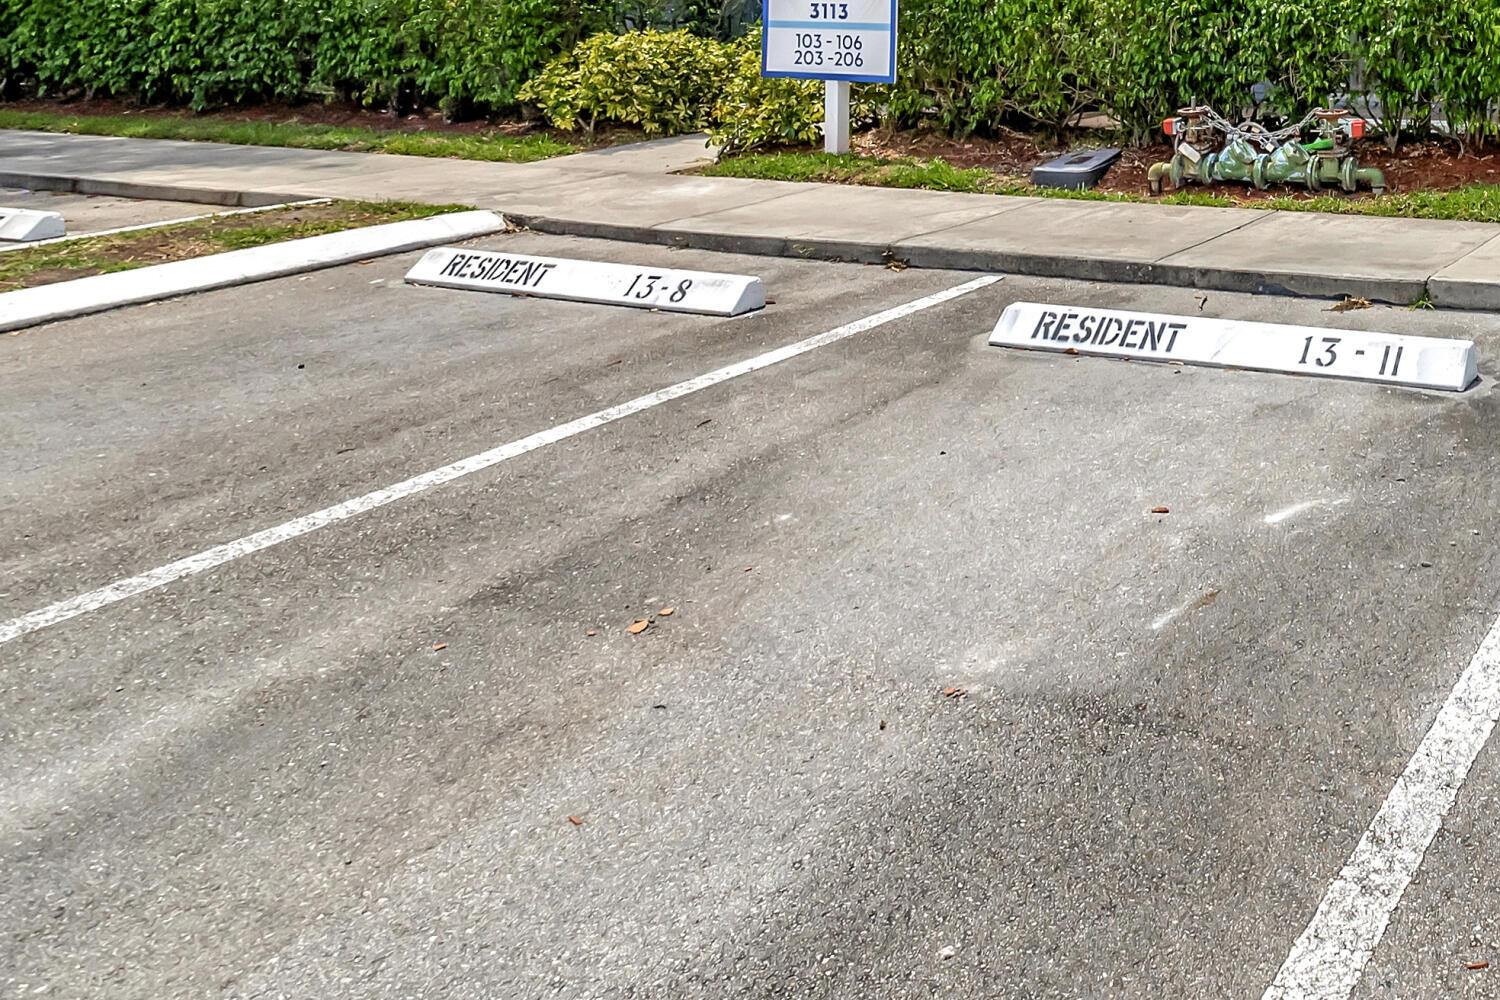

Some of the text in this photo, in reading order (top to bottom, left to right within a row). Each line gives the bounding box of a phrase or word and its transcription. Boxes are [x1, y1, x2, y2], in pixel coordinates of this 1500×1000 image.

[809, 2, 849, 20] 3113
[440, 254, 557, 287] RESIDENT
[1031, 311, 1188, 354] RESIDENT
